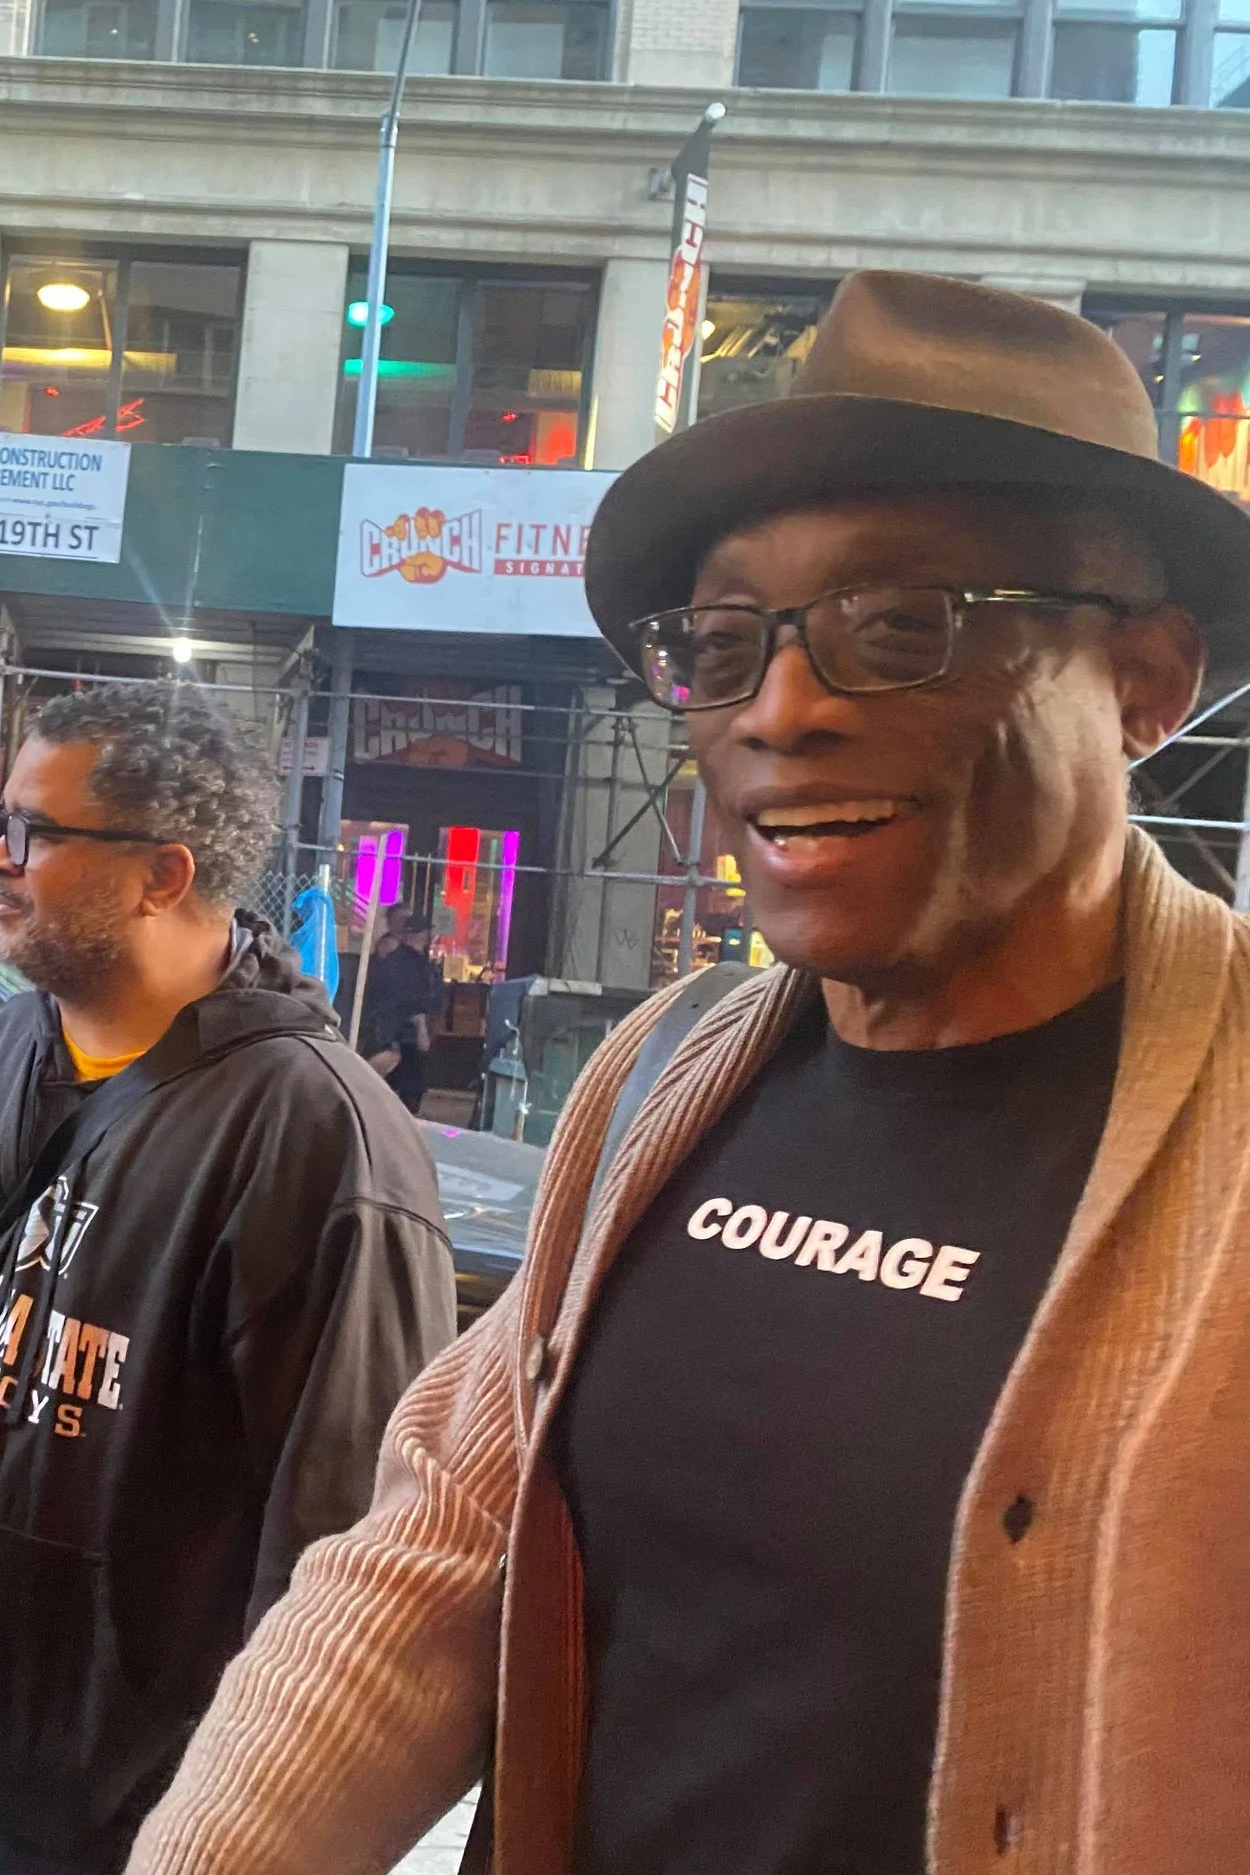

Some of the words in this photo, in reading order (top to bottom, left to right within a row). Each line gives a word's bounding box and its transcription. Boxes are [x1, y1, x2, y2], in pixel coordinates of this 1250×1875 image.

[51, 473, 76, 492] LLC
[67, 524, 100, 551] ST
[359, 508, 483, 578] CRUNCH
[687, 1197, 981, 1302] COURAGE
